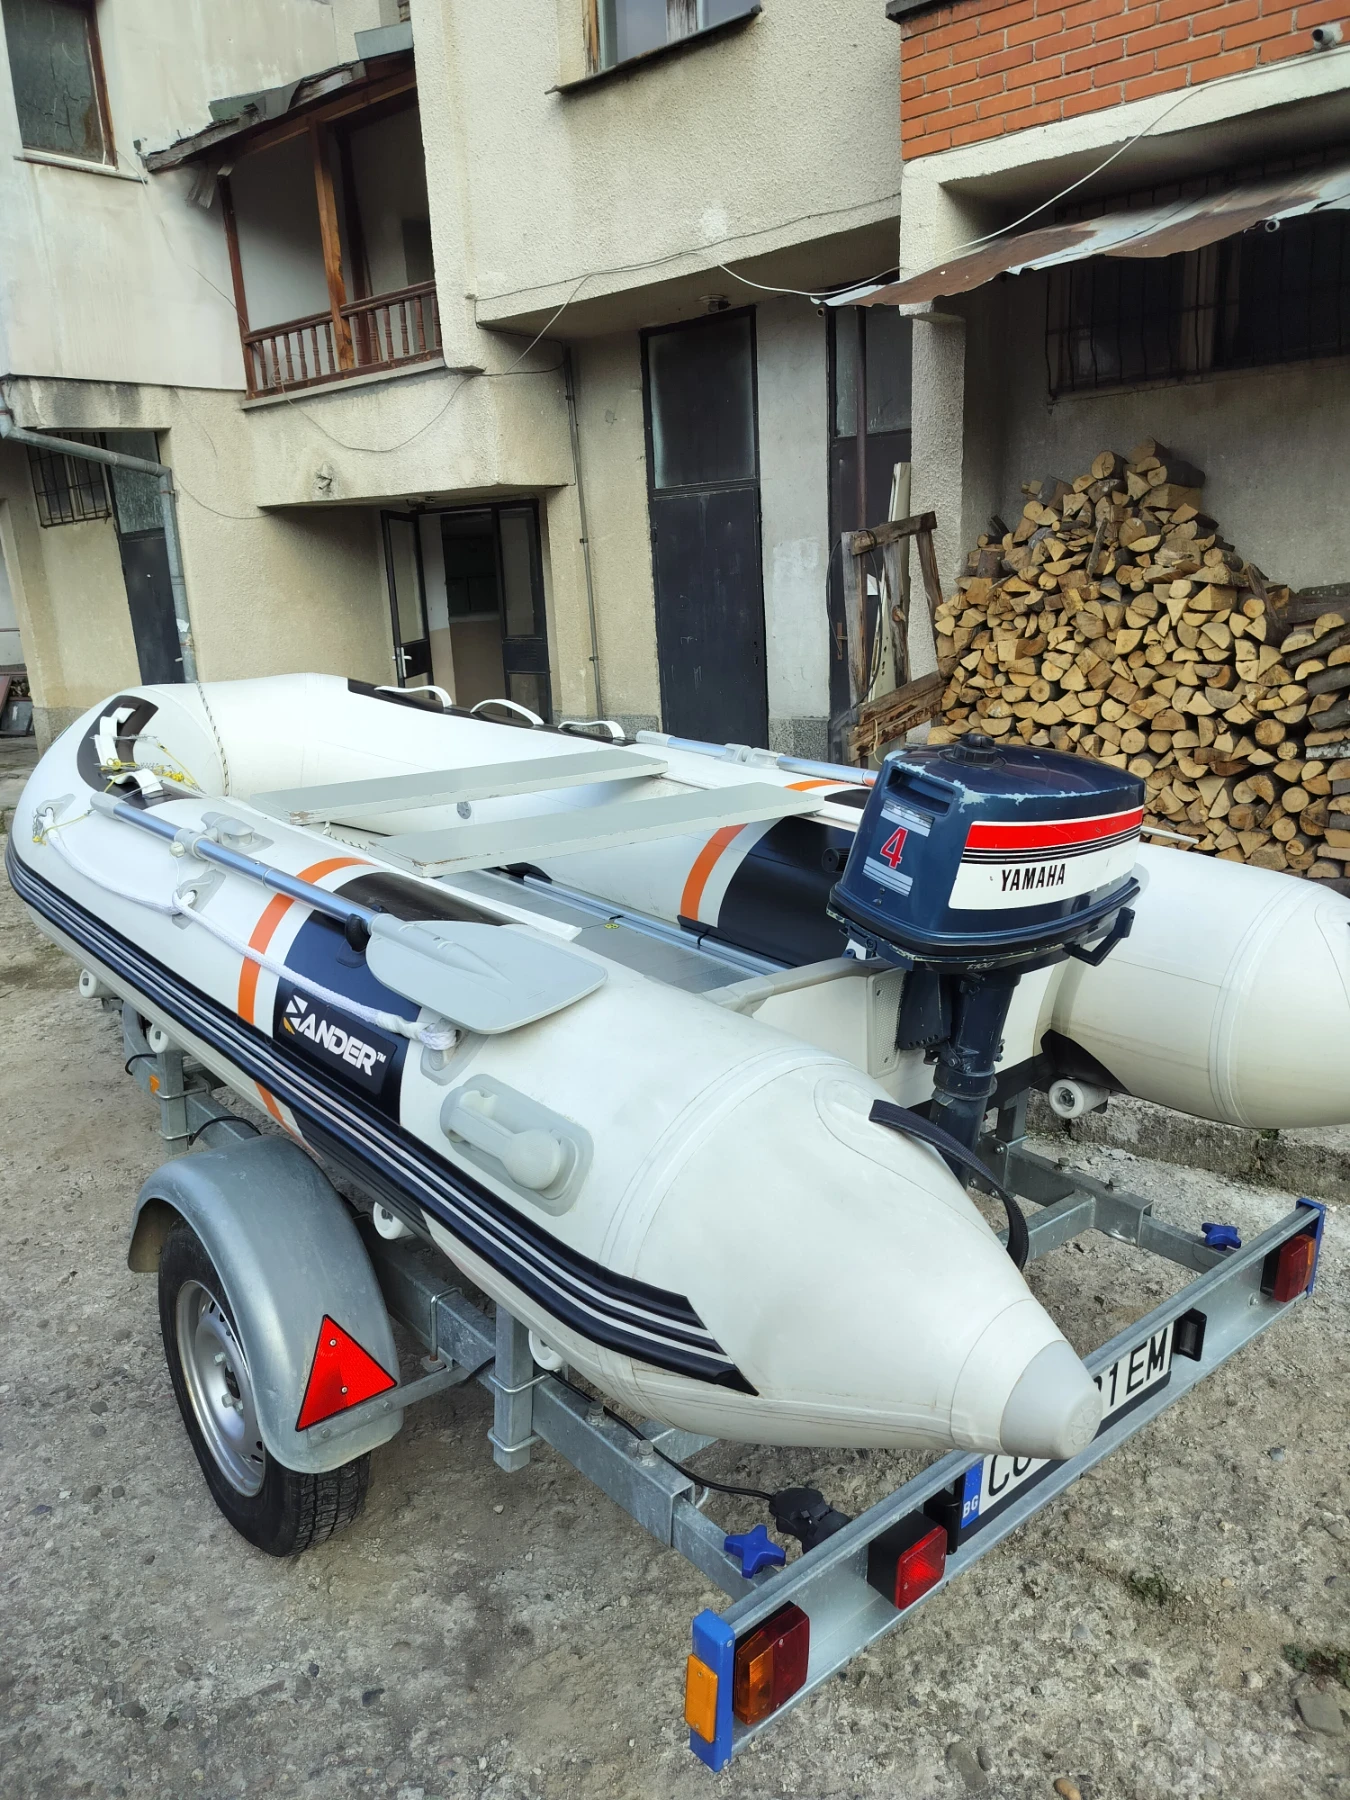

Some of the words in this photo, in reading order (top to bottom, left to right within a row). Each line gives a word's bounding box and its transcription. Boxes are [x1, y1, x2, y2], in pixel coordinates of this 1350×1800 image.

[880, 825, 909, 869] 4
[1000, 863, 1066, 892] YAMAHA
[962, 1494, 979, 1518] BG
